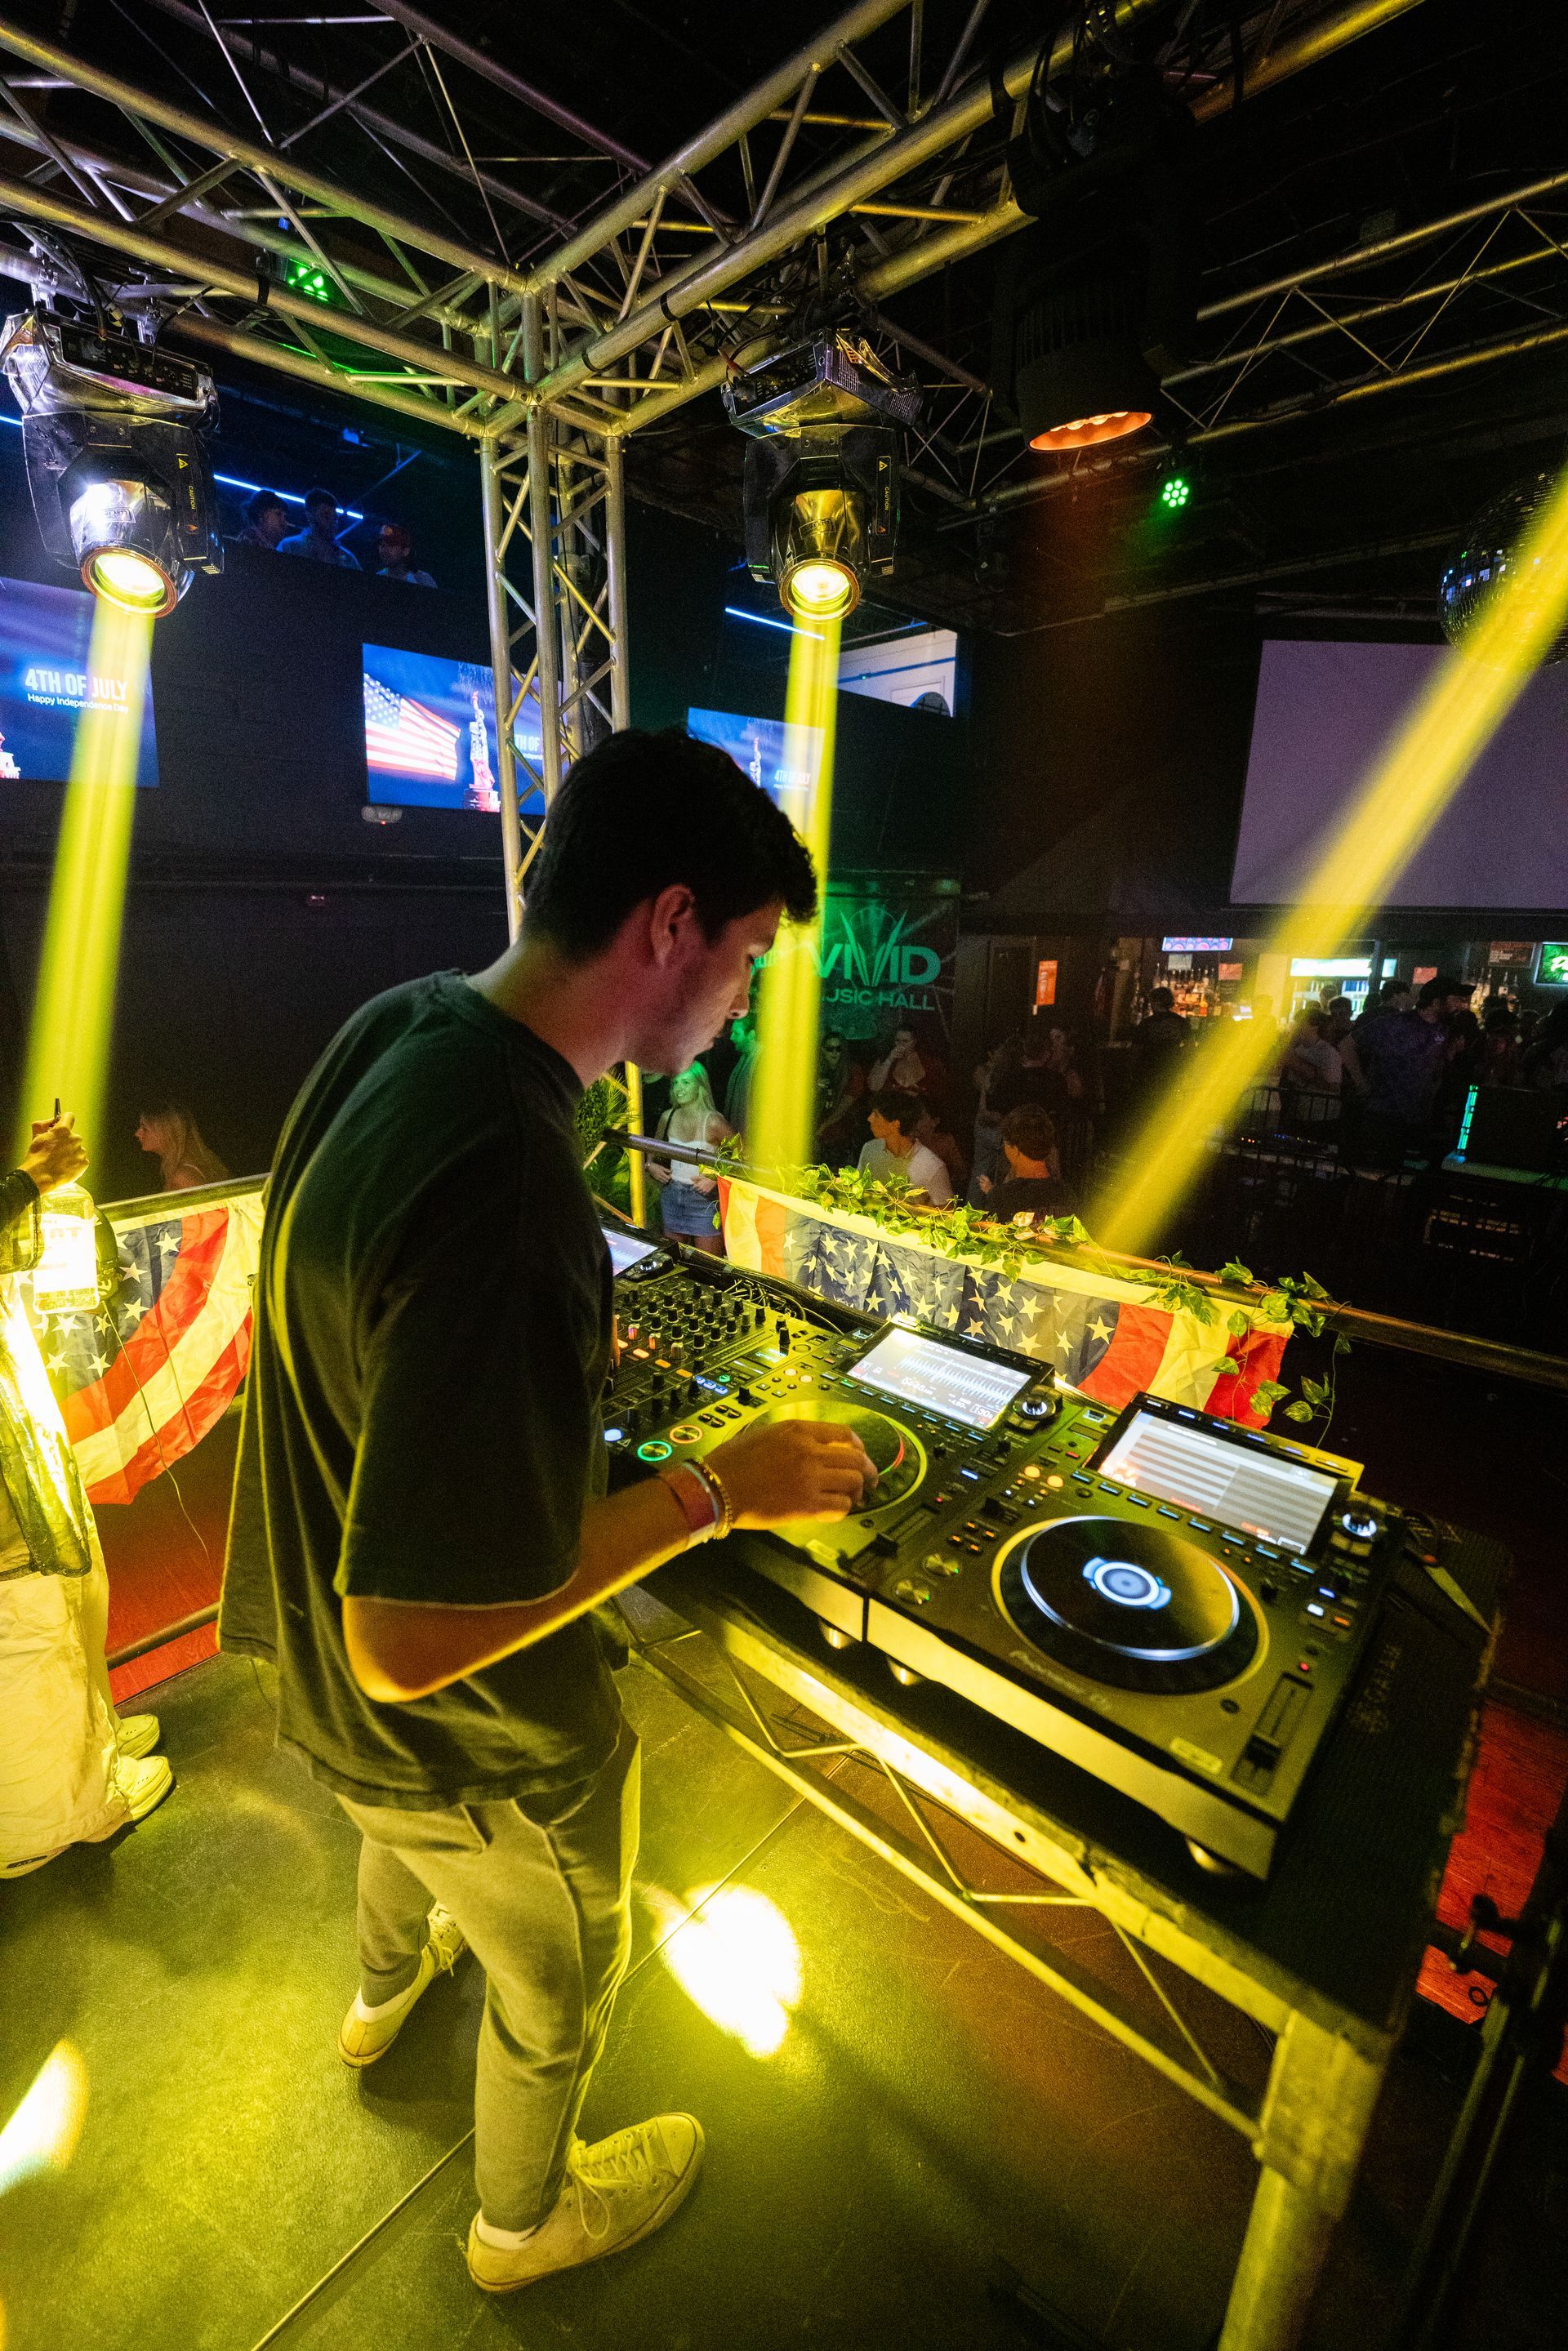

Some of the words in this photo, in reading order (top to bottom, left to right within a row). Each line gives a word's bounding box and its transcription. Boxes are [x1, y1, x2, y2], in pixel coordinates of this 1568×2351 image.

[24, 668, 62, 694] 4TH
[65, 673, 87, 697] OF
[91, 677, 128, 701] JULY
[27, 693, 55, 706] Happy
[56, 696, 113, 710] Independence
[113, 704, 129, 714] Day
[528, 735, 541, 752] OF
[879, 991, 935, 1011] HALL
